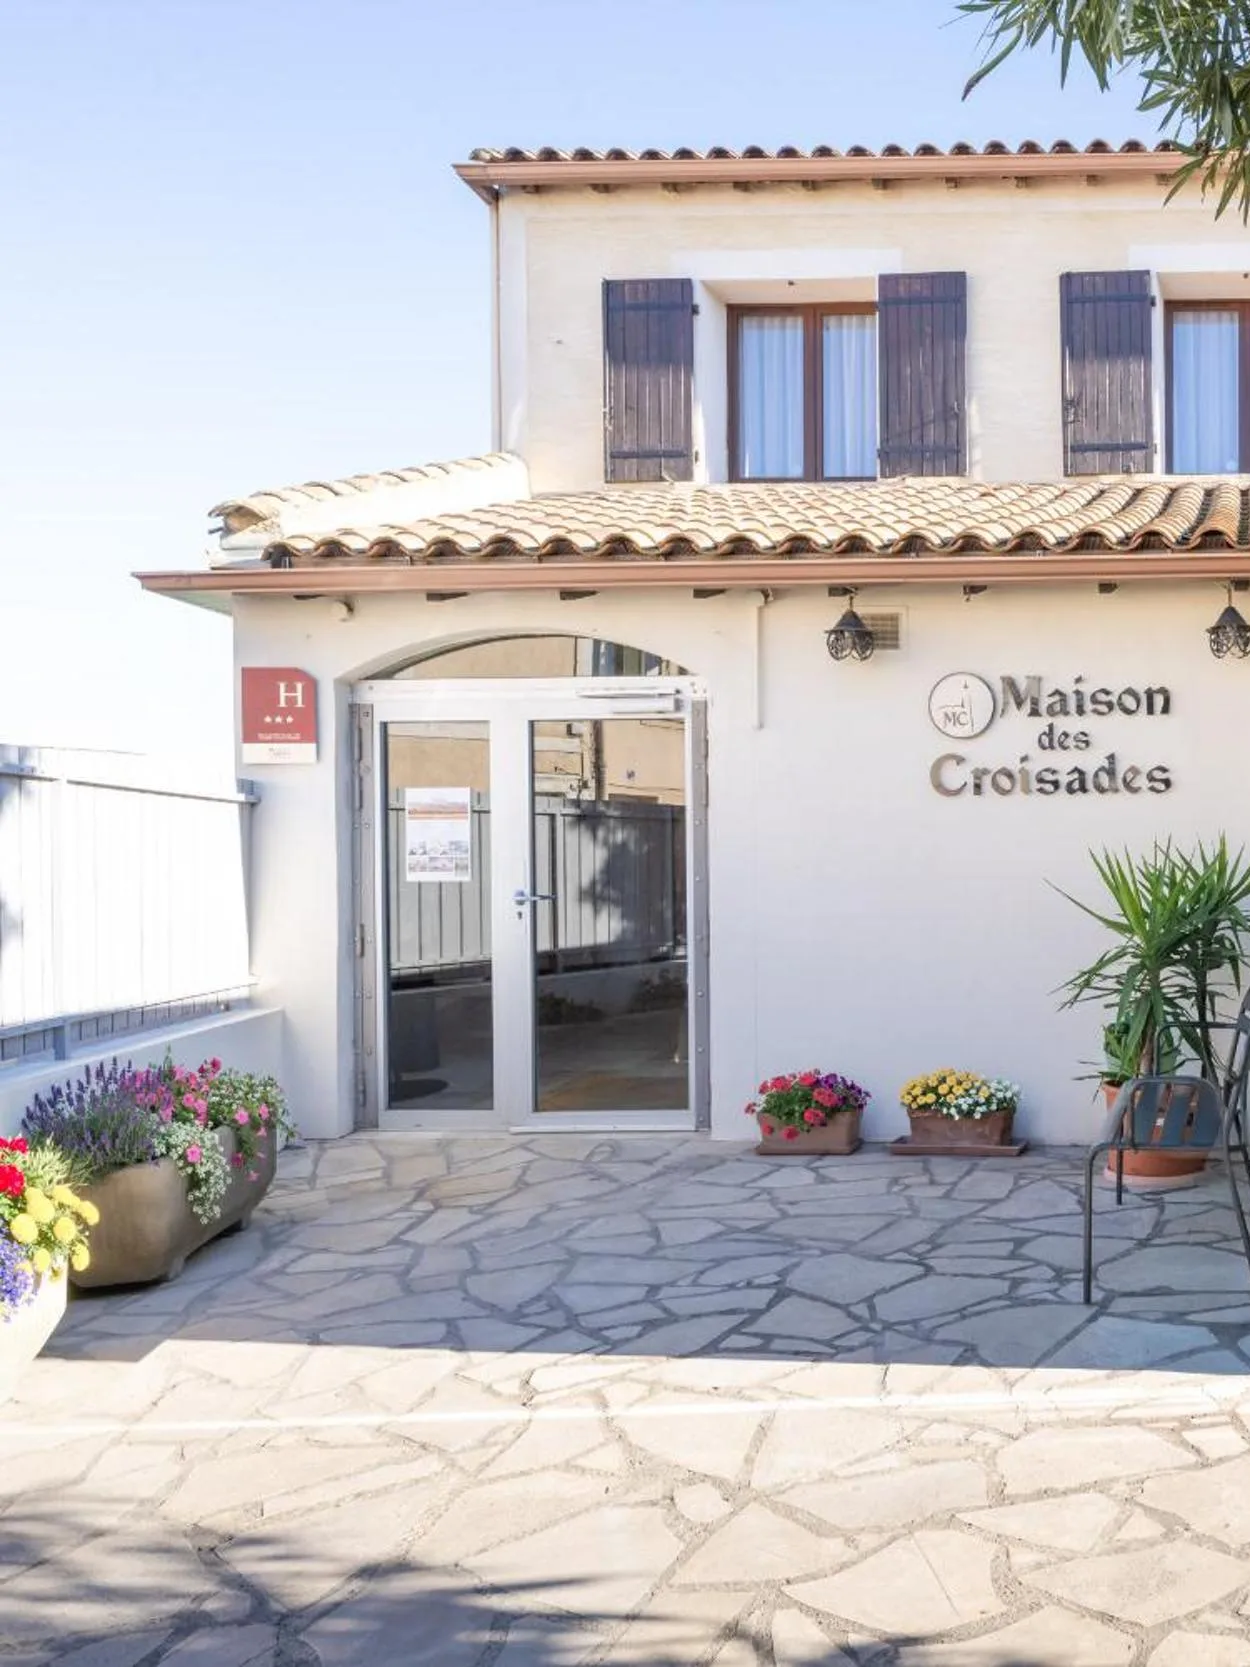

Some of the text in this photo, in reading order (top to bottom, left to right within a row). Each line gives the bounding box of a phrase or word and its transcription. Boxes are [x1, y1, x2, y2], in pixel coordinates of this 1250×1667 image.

[276, 681, 305, 708] H
[1000, 675, 1172, 718] Maison
[942, 710, 969, 728] MC
[1037, 722, 1091, 751] des
[929, 752, 1173, 796] Croisades
